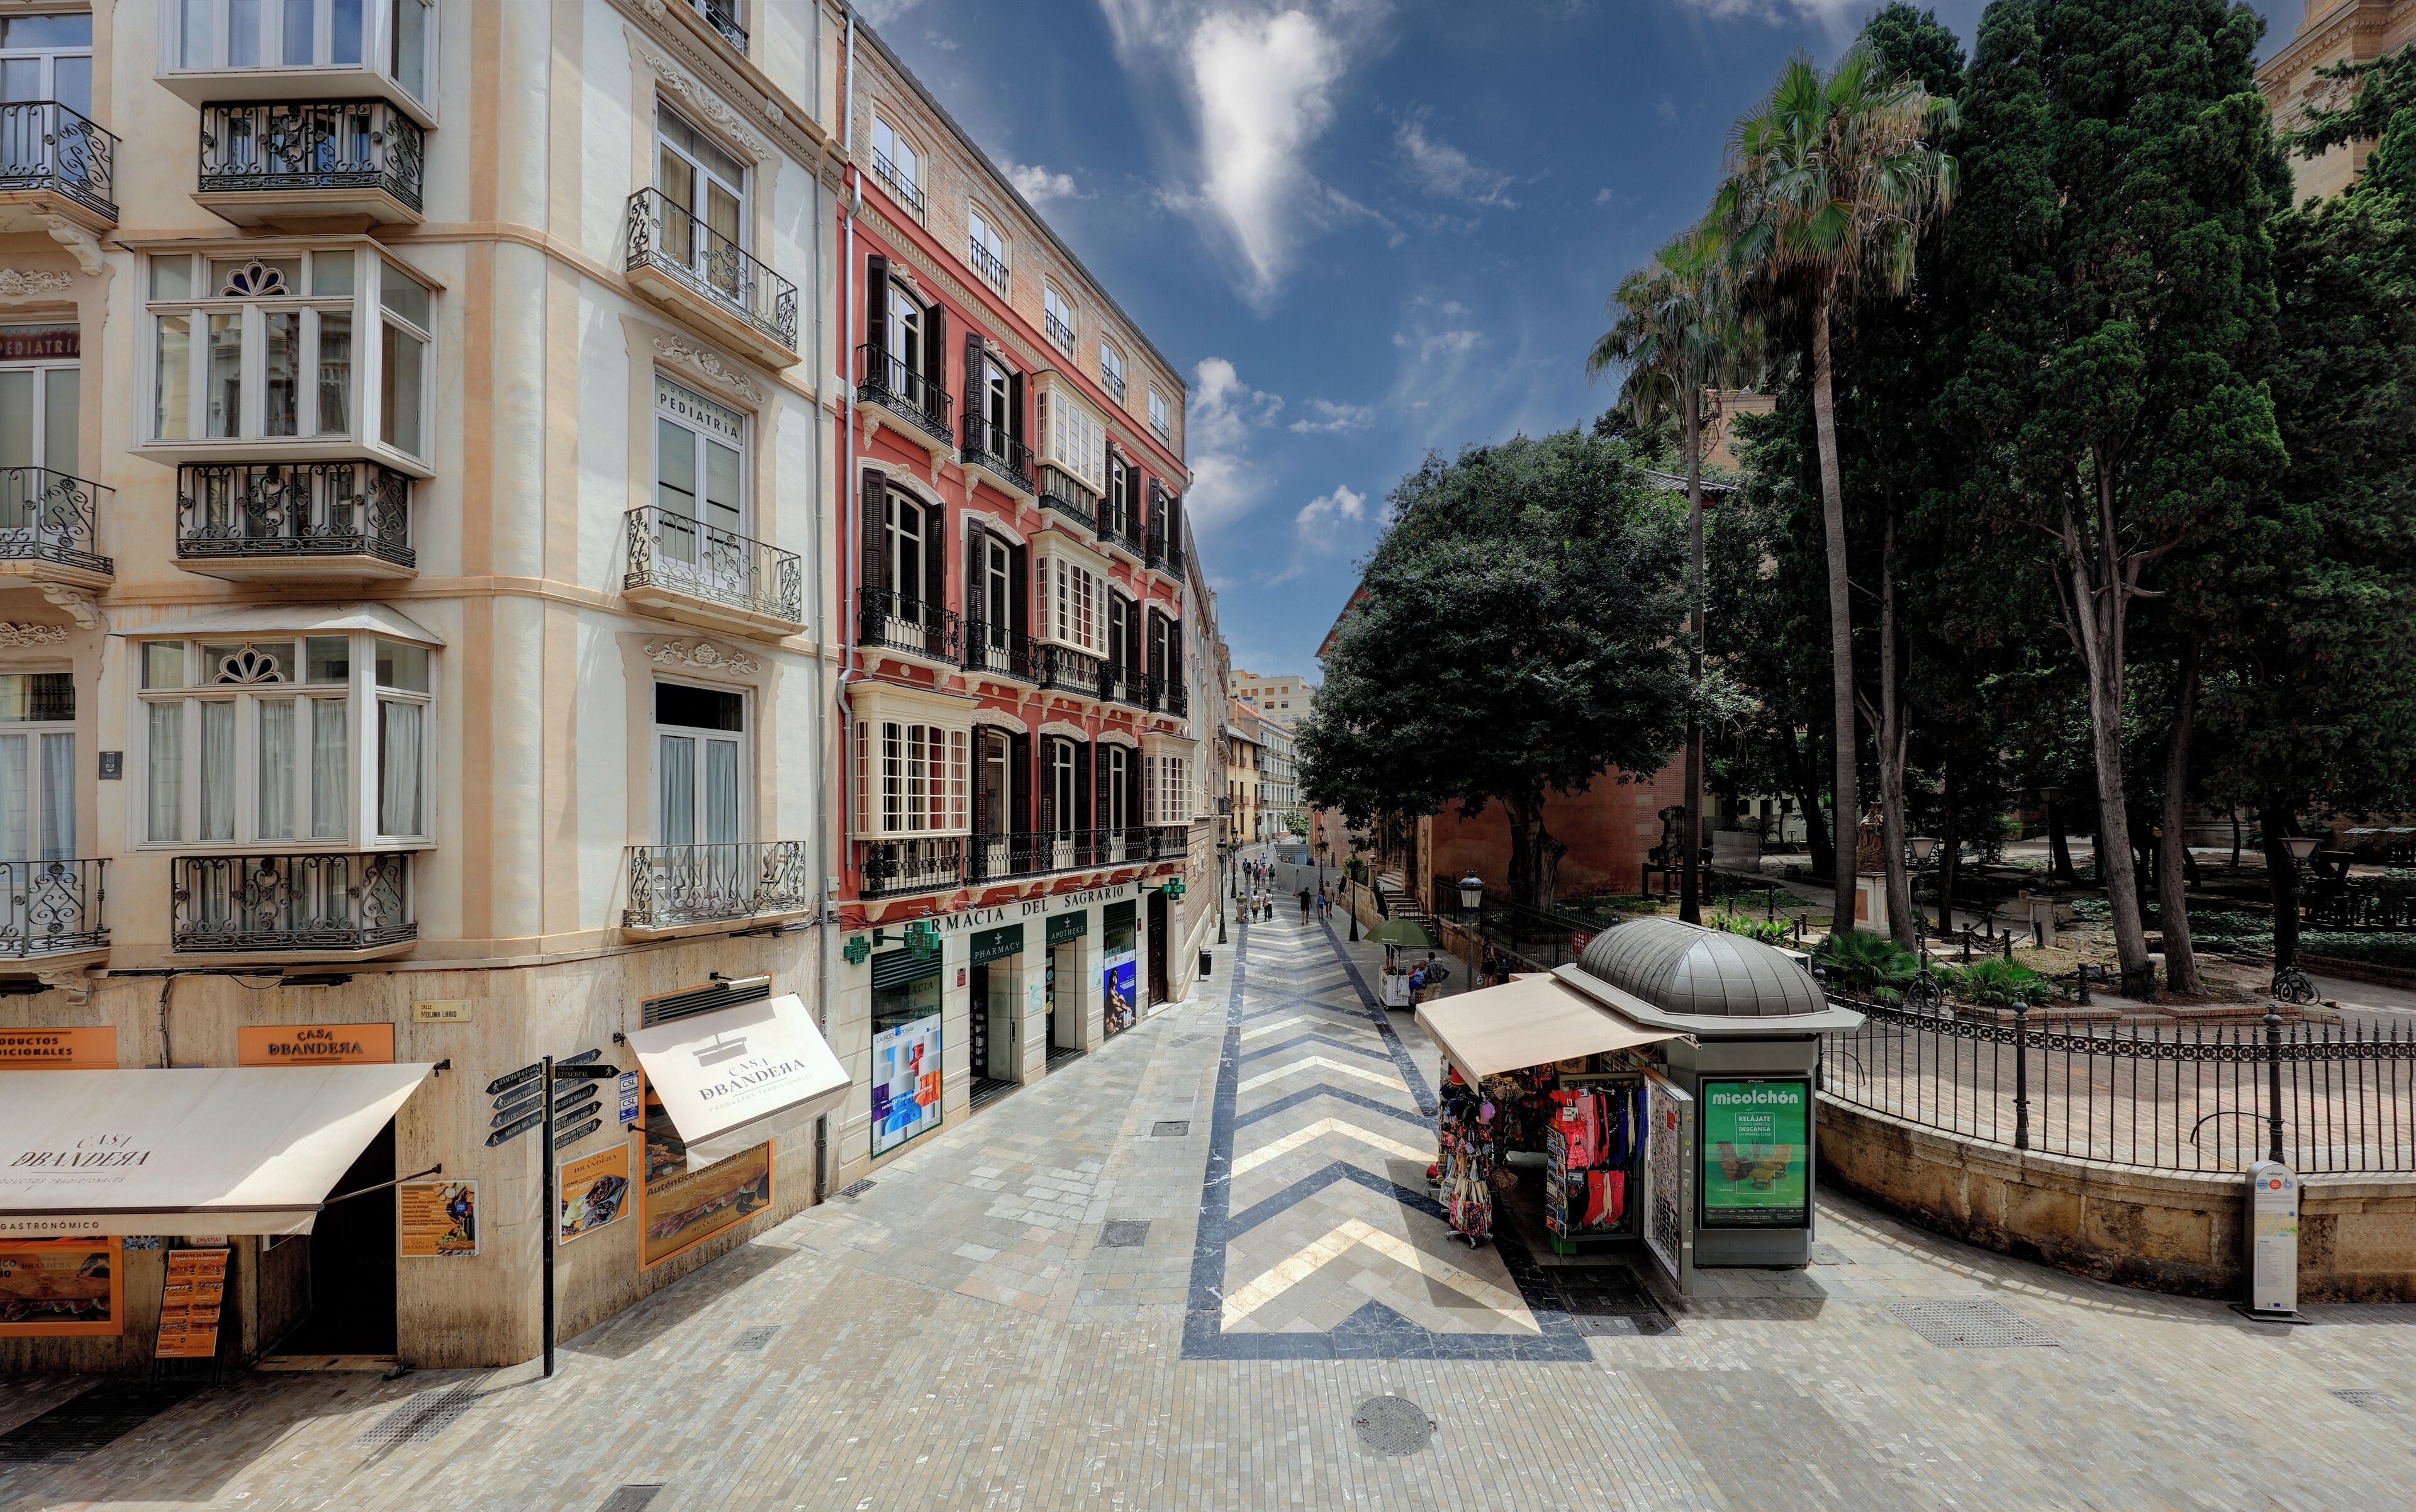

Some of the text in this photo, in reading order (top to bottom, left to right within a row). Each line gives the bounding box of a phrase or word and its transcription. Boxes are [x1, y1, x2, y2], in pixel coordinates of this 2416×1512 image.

[905, 886, 1124, 932] FRMACIA DEL SAGRARIO
[1051, 926, 1084, 940] APOTHEKE
[975, 941, 1020, 959] PHARMACY
[1108, 943, 1132, 956] SAGRARIO
[296, 1028, 333, 1041] CASA
[729, 1058, 768, 1077] CASA
[499, 1072, 520, 1086] HAMMAM
[529, 1079, 540, 1088] MUSEO
[556, 1079, 579, 1093] SAGRARIO
[622, 1078, 636, 1087] CSL
[503, 1085, 540, 1106] CARMEN THYSSEN
[555, 1100, 568, 1109] MUSEO
[574, 1090, 588, 1101] MÁLAGA
[709, 1073, 814, 1112] PRODUCTOS TRADICIONALES
[1712, 1090, 1798, 1105] micolchón
[510, 1100, 540, 1119] CONSTITUCIÓN
[622, 1098, 636, 1107] CSL
[505, 1125, 520, 1137] MUSEO
[530, 1114, 540, 1124] VINO
[556, 1116, 567, 1124] MUSEO
[556, 1117, 574, 1132] REVELLO
[581, 1110, 591, 1119] TORO
[556, 1122, 591, 1143] FUNDACIÓN PICASSO
[556, 1139, 569, 1150] MUSEO
[49, 1177, 126, 1185] TRADICIONALES
[646, 1172, 695, 1197] Auténtico
[659, 1156, 749, 1199] Authentic Iberian sandwich
[1, 1221, 99, 1230] GASTRONÓMICO
